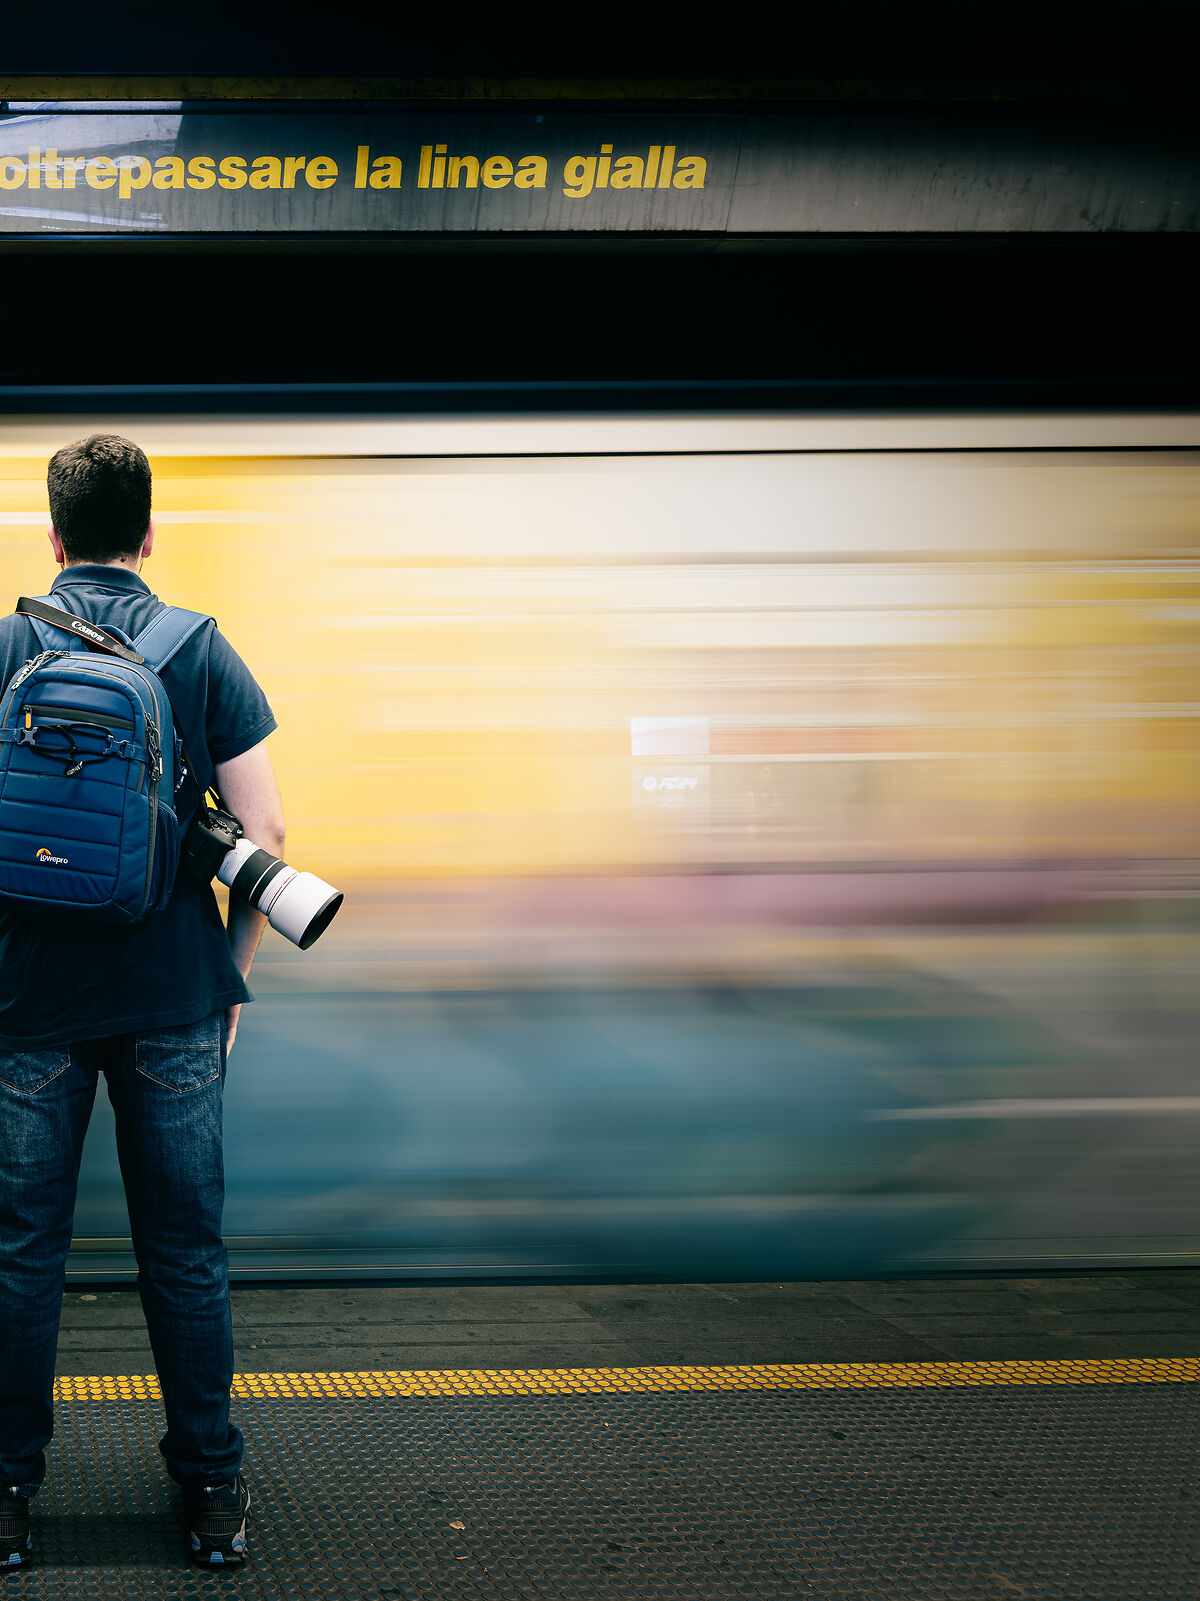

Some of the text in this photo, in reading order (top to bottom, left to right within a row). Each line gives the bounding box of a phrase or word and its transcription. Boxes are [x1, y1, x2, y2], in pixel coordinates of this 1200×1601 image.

[354, 145, 403, 189] la
[417, 144, 548, 189] linea
[562, 143, 708, 198] gialla
[71, 620, 105, 642] Canon
[40, 854, 69, 864] Lowepro
